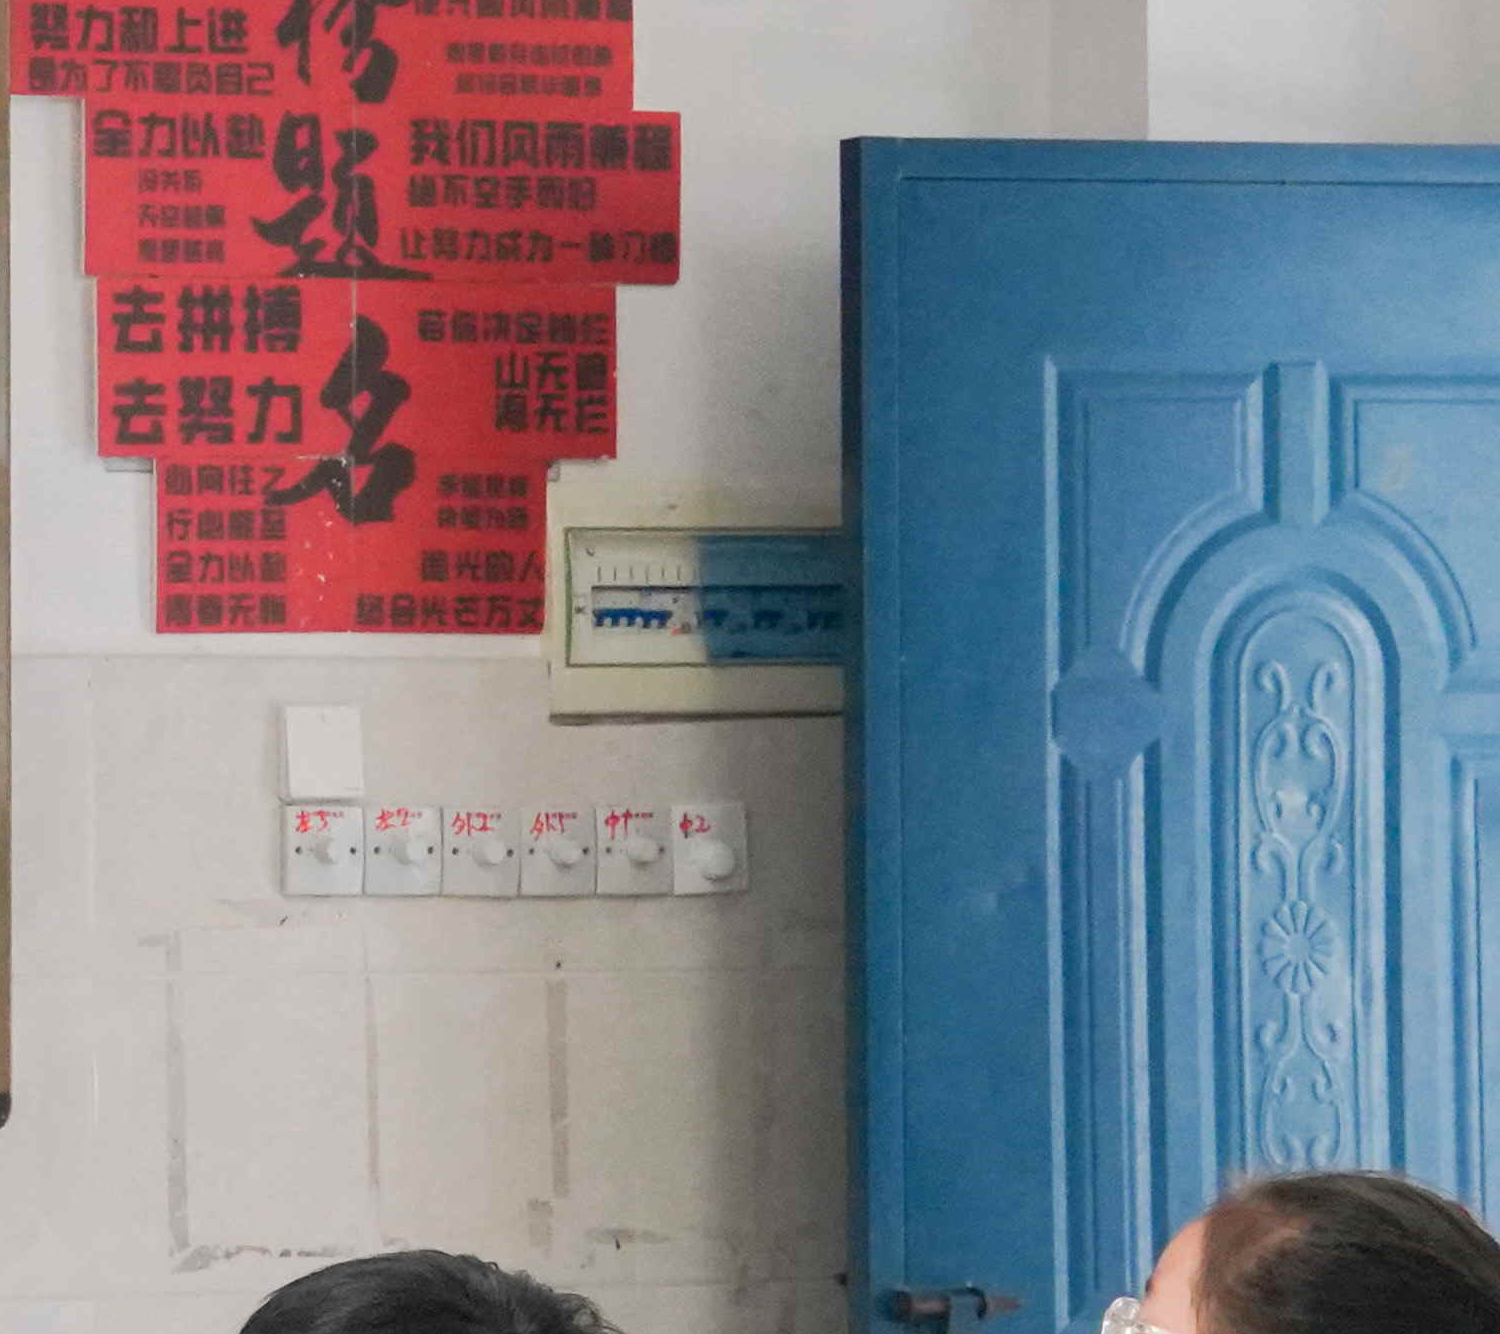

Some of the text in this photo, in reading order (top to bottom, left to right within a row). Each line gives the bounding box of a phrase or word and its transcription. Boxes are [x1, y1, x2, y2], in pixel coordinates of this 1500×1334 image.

[29, 2, 248, 54] 努力和上进
[93, 110, 266, 159] 全力以赴
[410, 117, 673, 172] 我们风雨兼程
[408, 174, 598, 212] 绝不空手而归
[401, 226, 678, 264] 让努力成为一种习惯
[110, 284, 303, 354] 去拼搏
[111, 376, 303, 446] 去努力
[165, 550, 288, 584] 全力以赴
